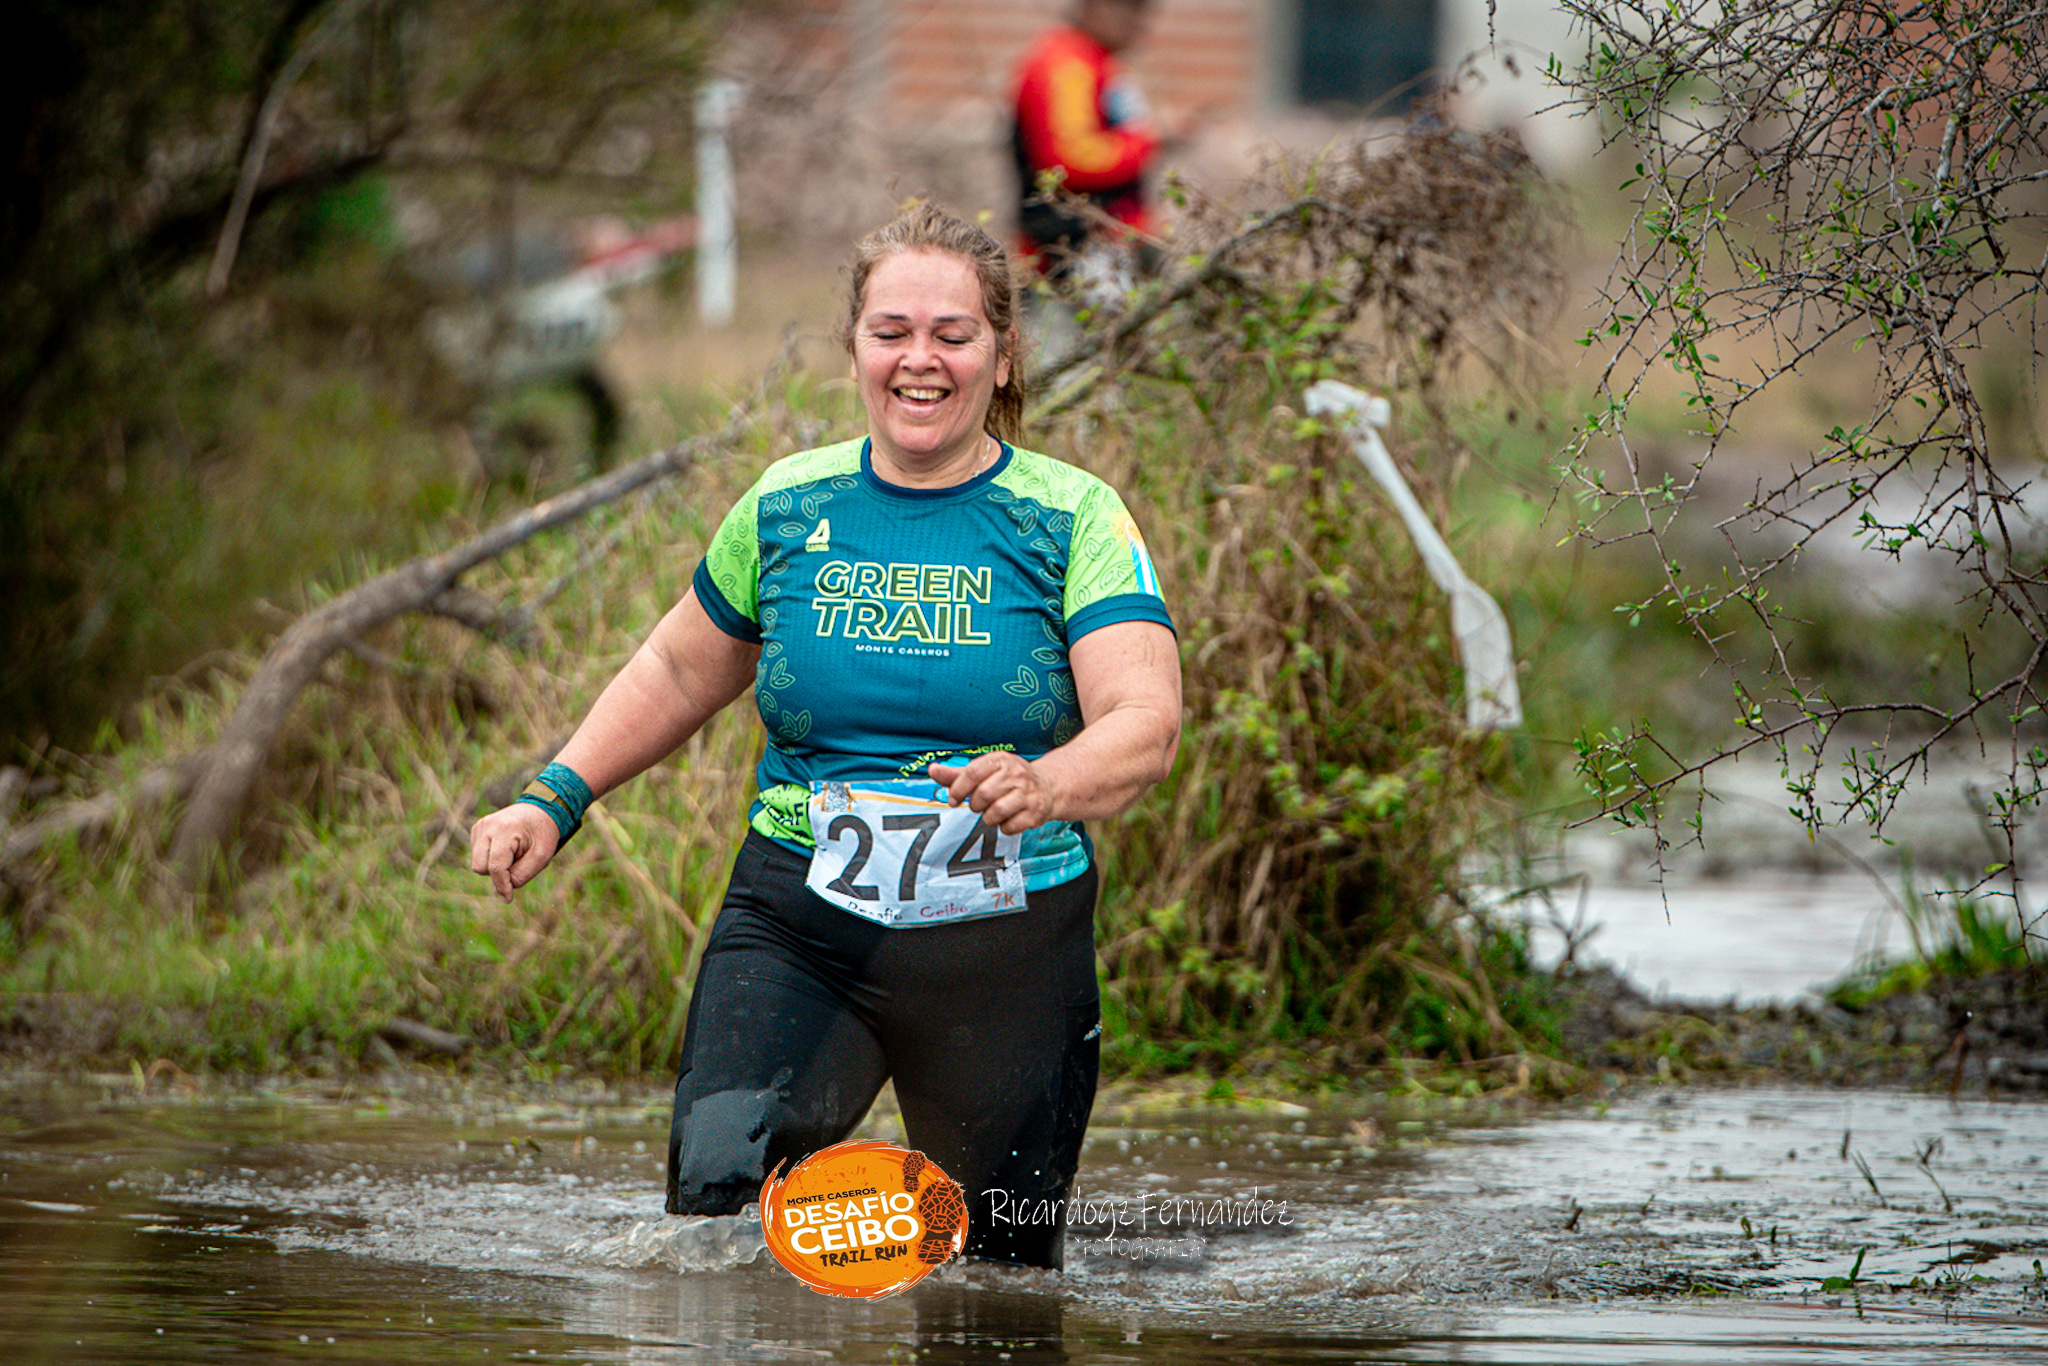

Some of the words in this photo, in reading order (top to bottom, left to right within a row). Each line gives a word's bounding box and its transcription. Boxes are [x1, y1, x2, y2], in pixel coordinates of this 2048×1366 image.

[814, 560, 992, 603] GREEN
[812, 597, 991, 645] TRAIL
[855, 644, 895, 654] MONTE
[898, 647, 950, 657] CASEROS
[826, 812, 1006, 902] 274
[919, 902, 969, 919] Ceibo
